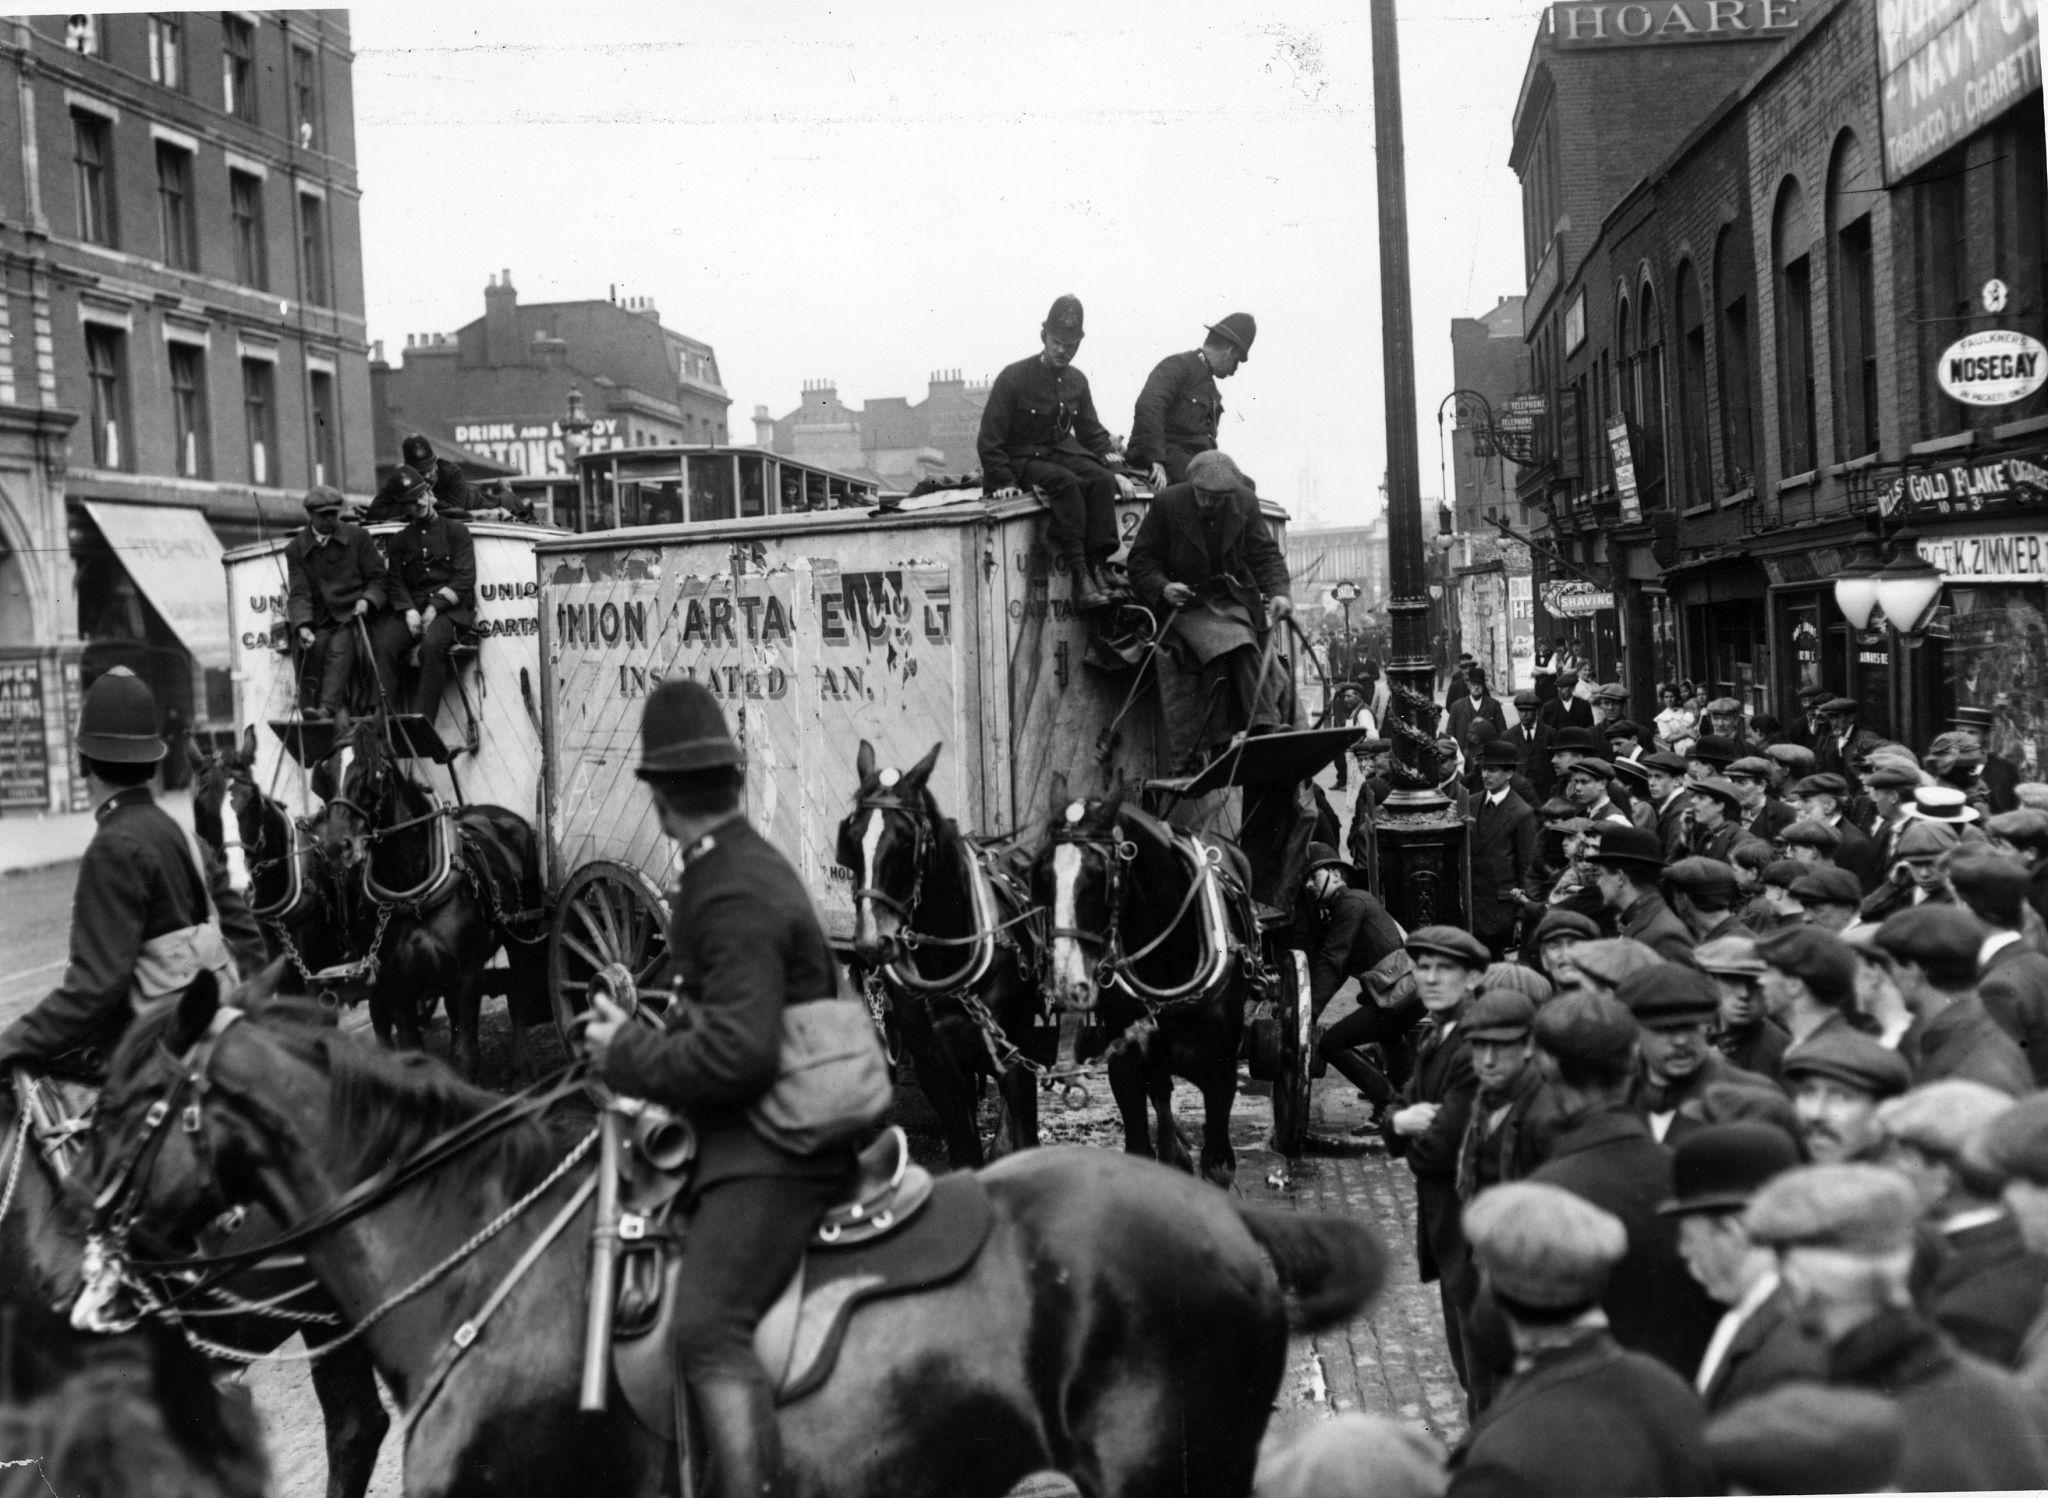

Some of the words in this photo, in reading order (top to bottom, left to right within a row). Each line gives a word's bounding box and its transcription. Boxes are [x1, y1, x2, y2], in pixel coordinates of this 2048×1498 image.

[1565, 0, 1799, 39] HOARE
[1908, 8, 1980, 109] NAVY
[1887, 107, 1947, 173] TOBACCO
[1950, 352, 2039, 383] NOSEGAY
[455, 423, 515, 442] DRINK
[520, 426, 548, 439] AND
[1121, 511, 1141, 543] 2
[1561, 594, 1613, 608] SHAVING
